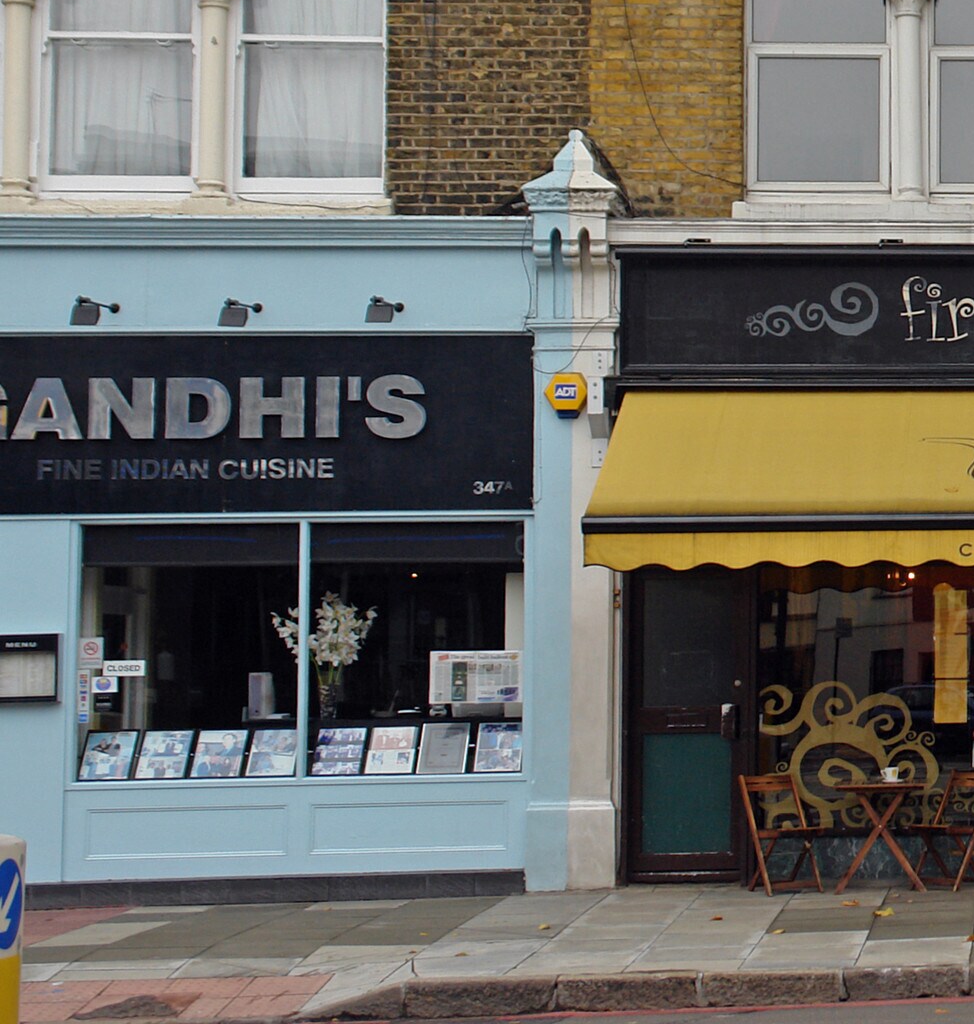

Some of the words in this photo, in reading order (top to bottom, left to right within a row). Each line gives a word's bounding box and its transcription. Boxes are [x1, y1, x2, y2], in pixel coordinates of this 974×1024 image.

[554, 386, 577, 397] ADT
[0, 374, 427, 440] ANDHI'S
[36, 458, 102, 480] FINE
[110, 458, 209, 480] INDIAN
[218, 457, 335, 480] CUISINE
[106, 664, 141, 672] CLOSED
